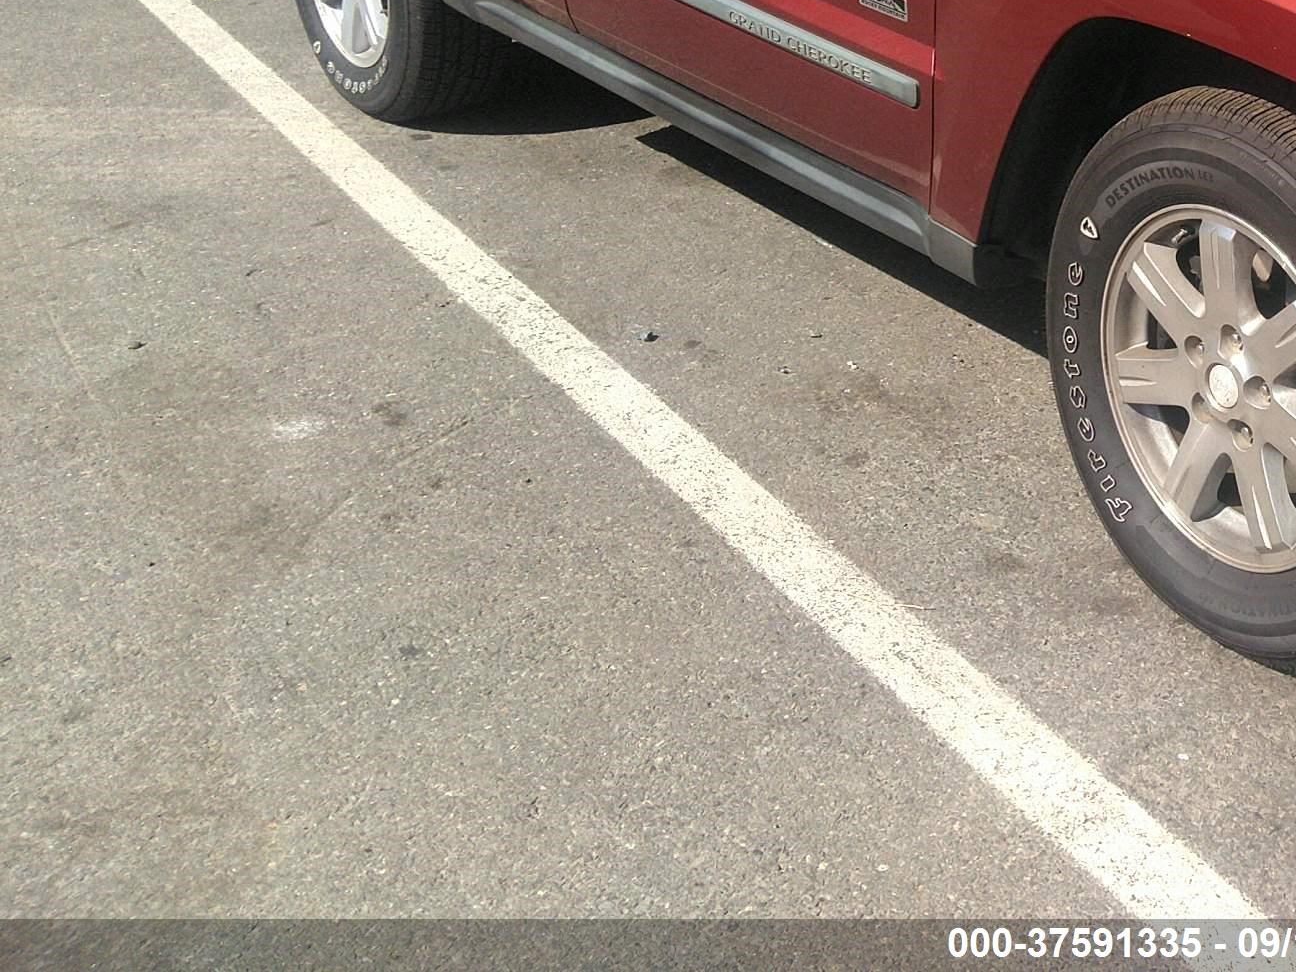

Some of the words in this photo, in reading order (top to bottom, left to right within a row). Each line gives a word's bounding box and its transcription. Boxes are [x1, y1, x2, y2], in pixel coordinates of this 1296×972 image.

[729, 10, 782, 44] GRAND
[786, 35, 873, 84] CHEROKEE
[1104, 165, 1196, 209] DESTINATION
[1062, 261, 1134, 524] Firestone
